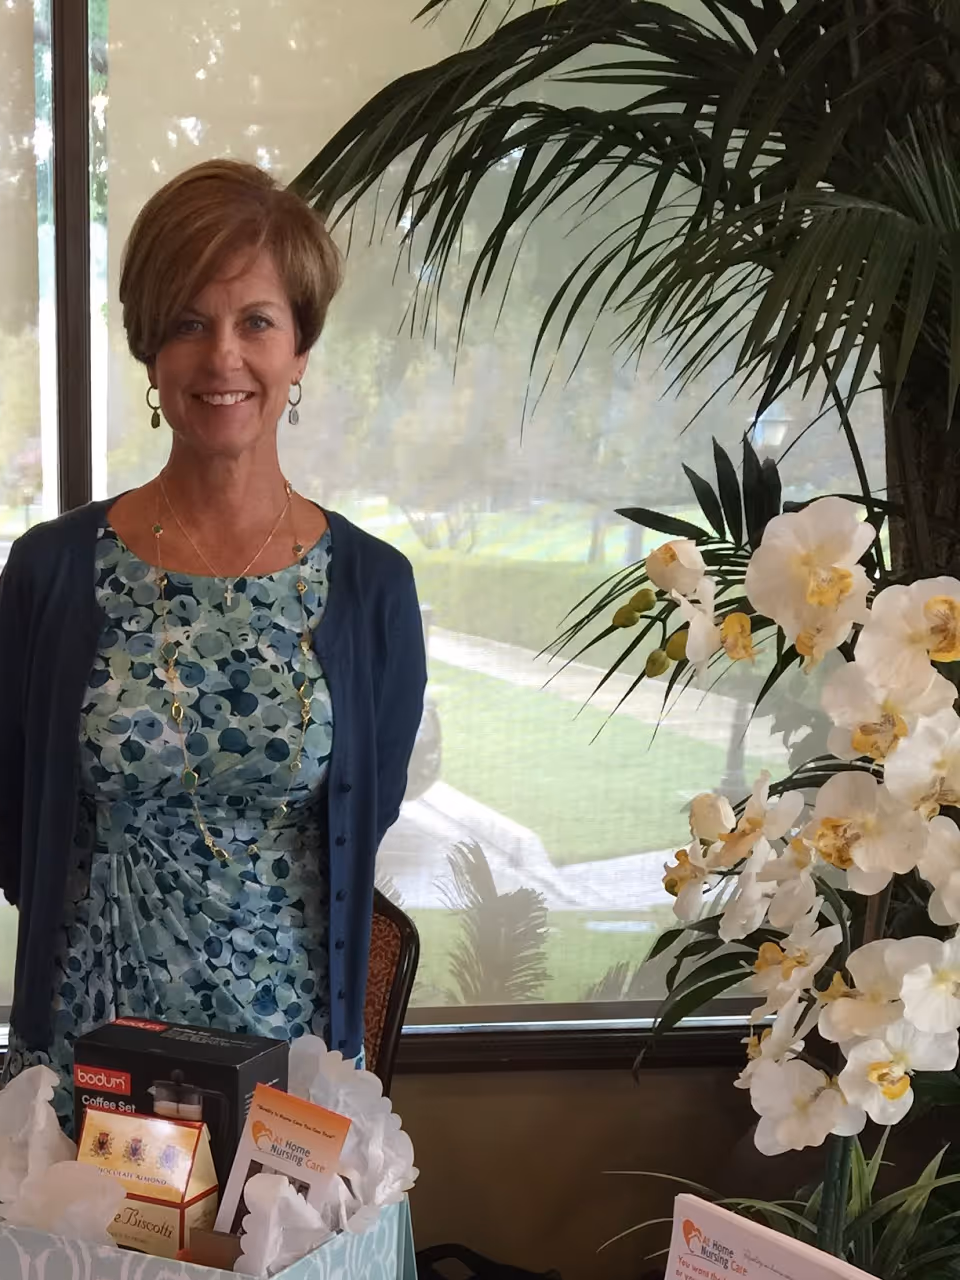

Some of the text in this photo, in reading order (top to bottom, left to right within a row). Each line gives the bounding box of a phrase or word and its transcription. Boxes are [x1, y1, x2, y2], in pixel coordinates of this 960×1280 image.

[77, 1069, 126, 1089] bodum
[81, 1094, 136, 1113] Coffee Set
[273, 1136, 311, 1157] At Home
[270, 1144, 326, 1173] Nursing Care
[121, 1207, 174, 1239] Biscotti
[702, 1235, 735, 1259] At Home
[677, 1255, 691, 1269] You
[690, 1264, 709, 1278] want
[701, 1246, 749, 1277] Nursing Care
